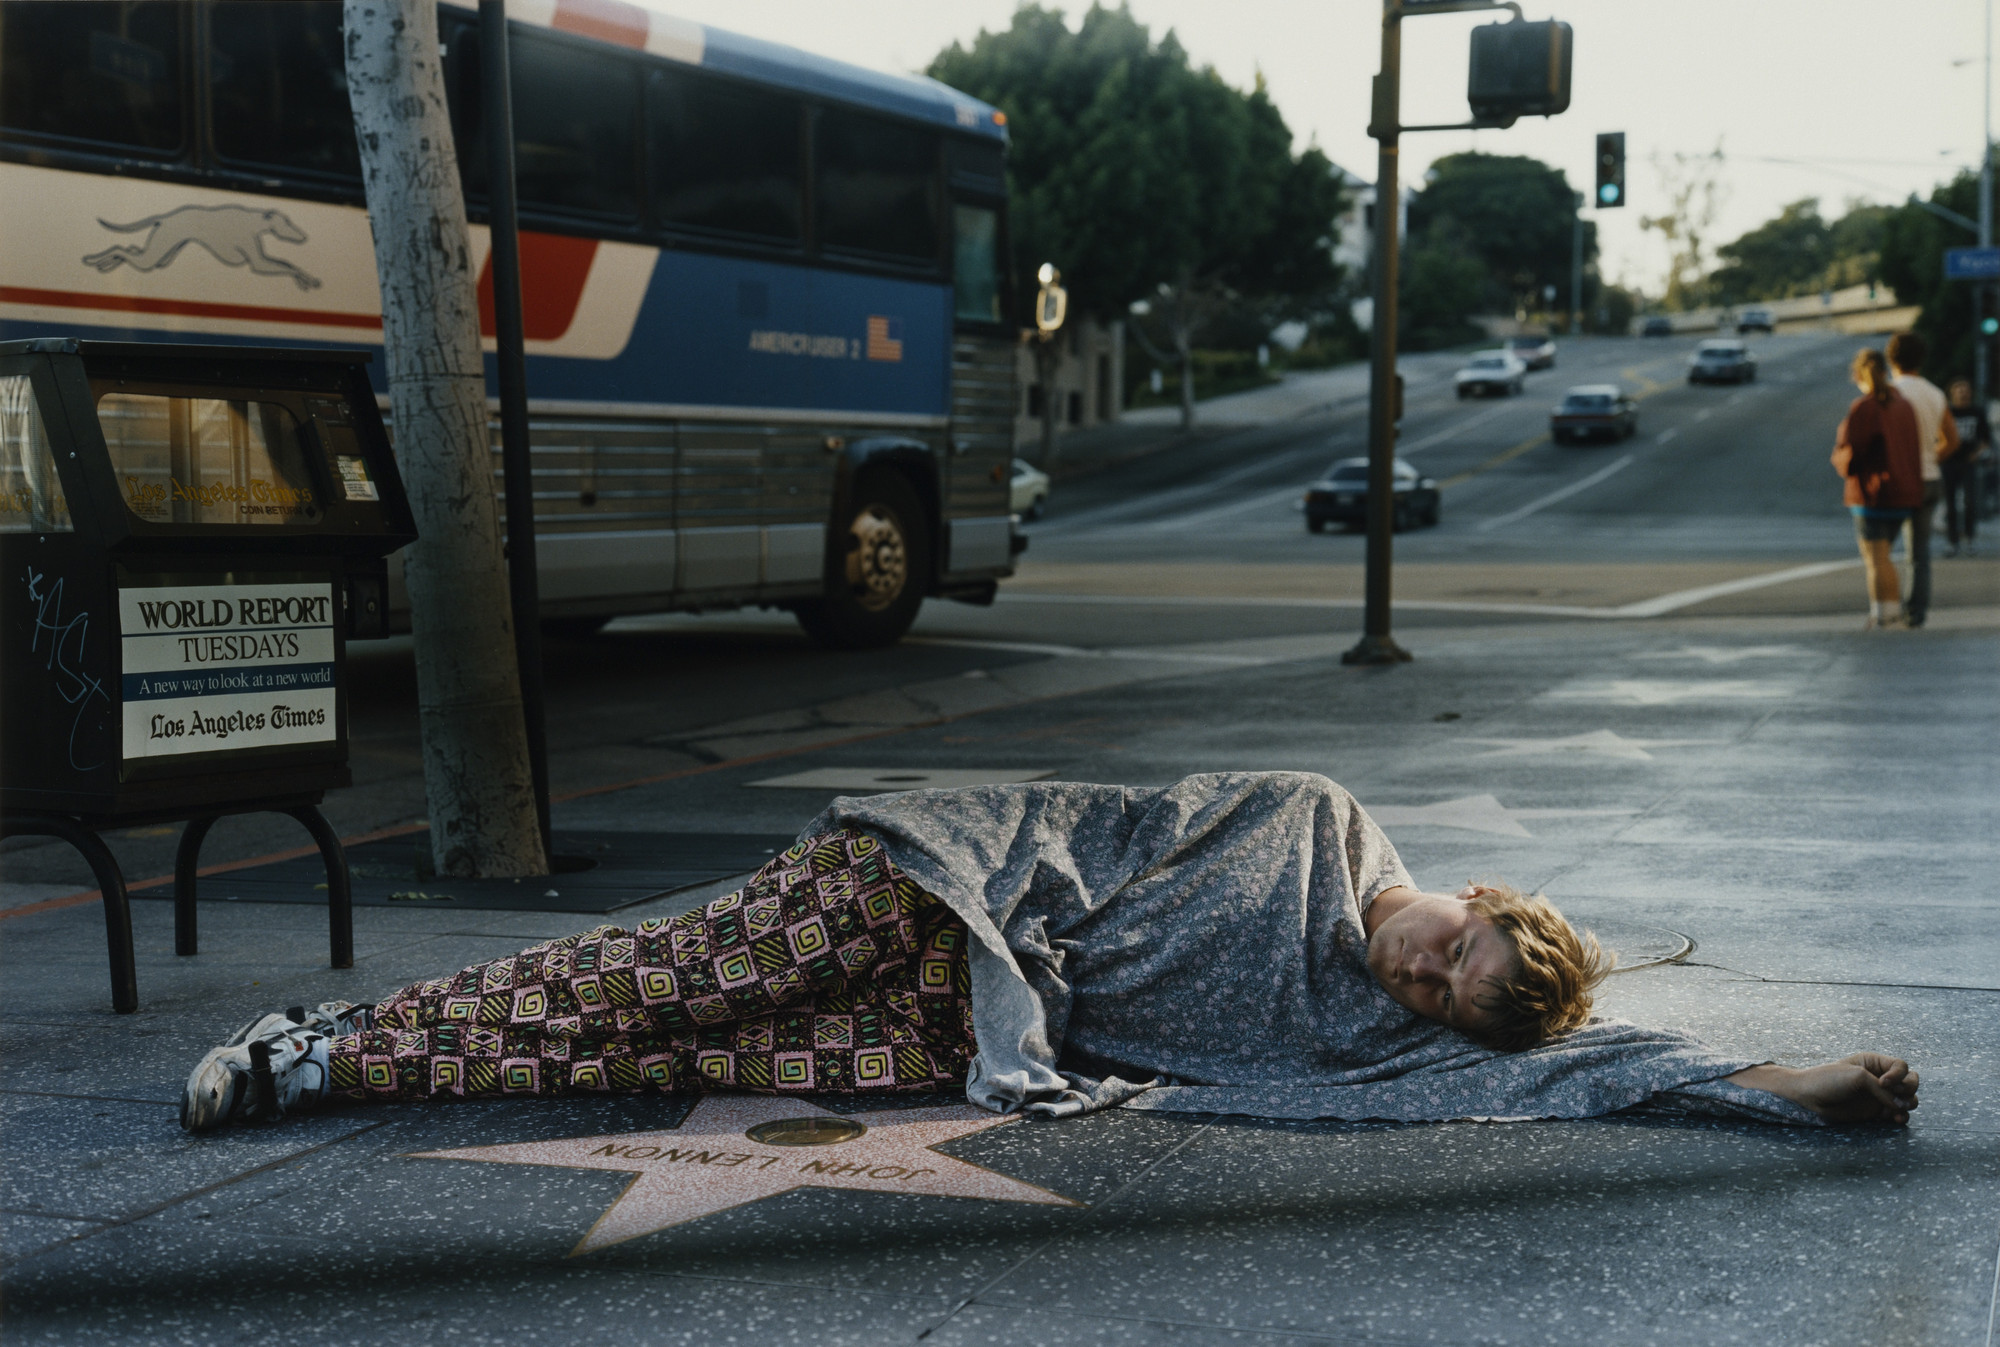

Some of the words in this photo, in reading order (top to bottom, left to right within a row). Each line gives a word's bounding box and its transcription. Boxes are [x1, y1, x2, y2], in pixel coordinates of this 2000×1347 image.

[850, 337, 861, 361] 2
[125, 476, 167, 501] Los
[170, 477, 249, 507] Angeles
[250, 479, 313, 503] Times
[240, 505, 264, 515] COIN
[265, 506, 302, 516] RETURN
[138, 599, 234, 630] WORLD
[238, 596, 330, 626] REPORT
[178, 633, 299, 663] TUESDAYS
[139, 679, 151, 695] A
[154, 680, 179, 694] new
[182, 678, 204, 694] way
[208, 675, 219, 690] to
[220, 672, 249, 689] look
[252, 673, 263, 687] at
[266, 675, 273, 686] a
[276, 672, 298, 685] new
[301, 667, 331, 683] world
[151, 714, 185, 739] Los
[188, 710, 266, 738] Angeles
[271, 705, 325, 729] Times
[590, 1143, 780, 1170] LENNON
[799, 1160, 937, 1180] JOHN
